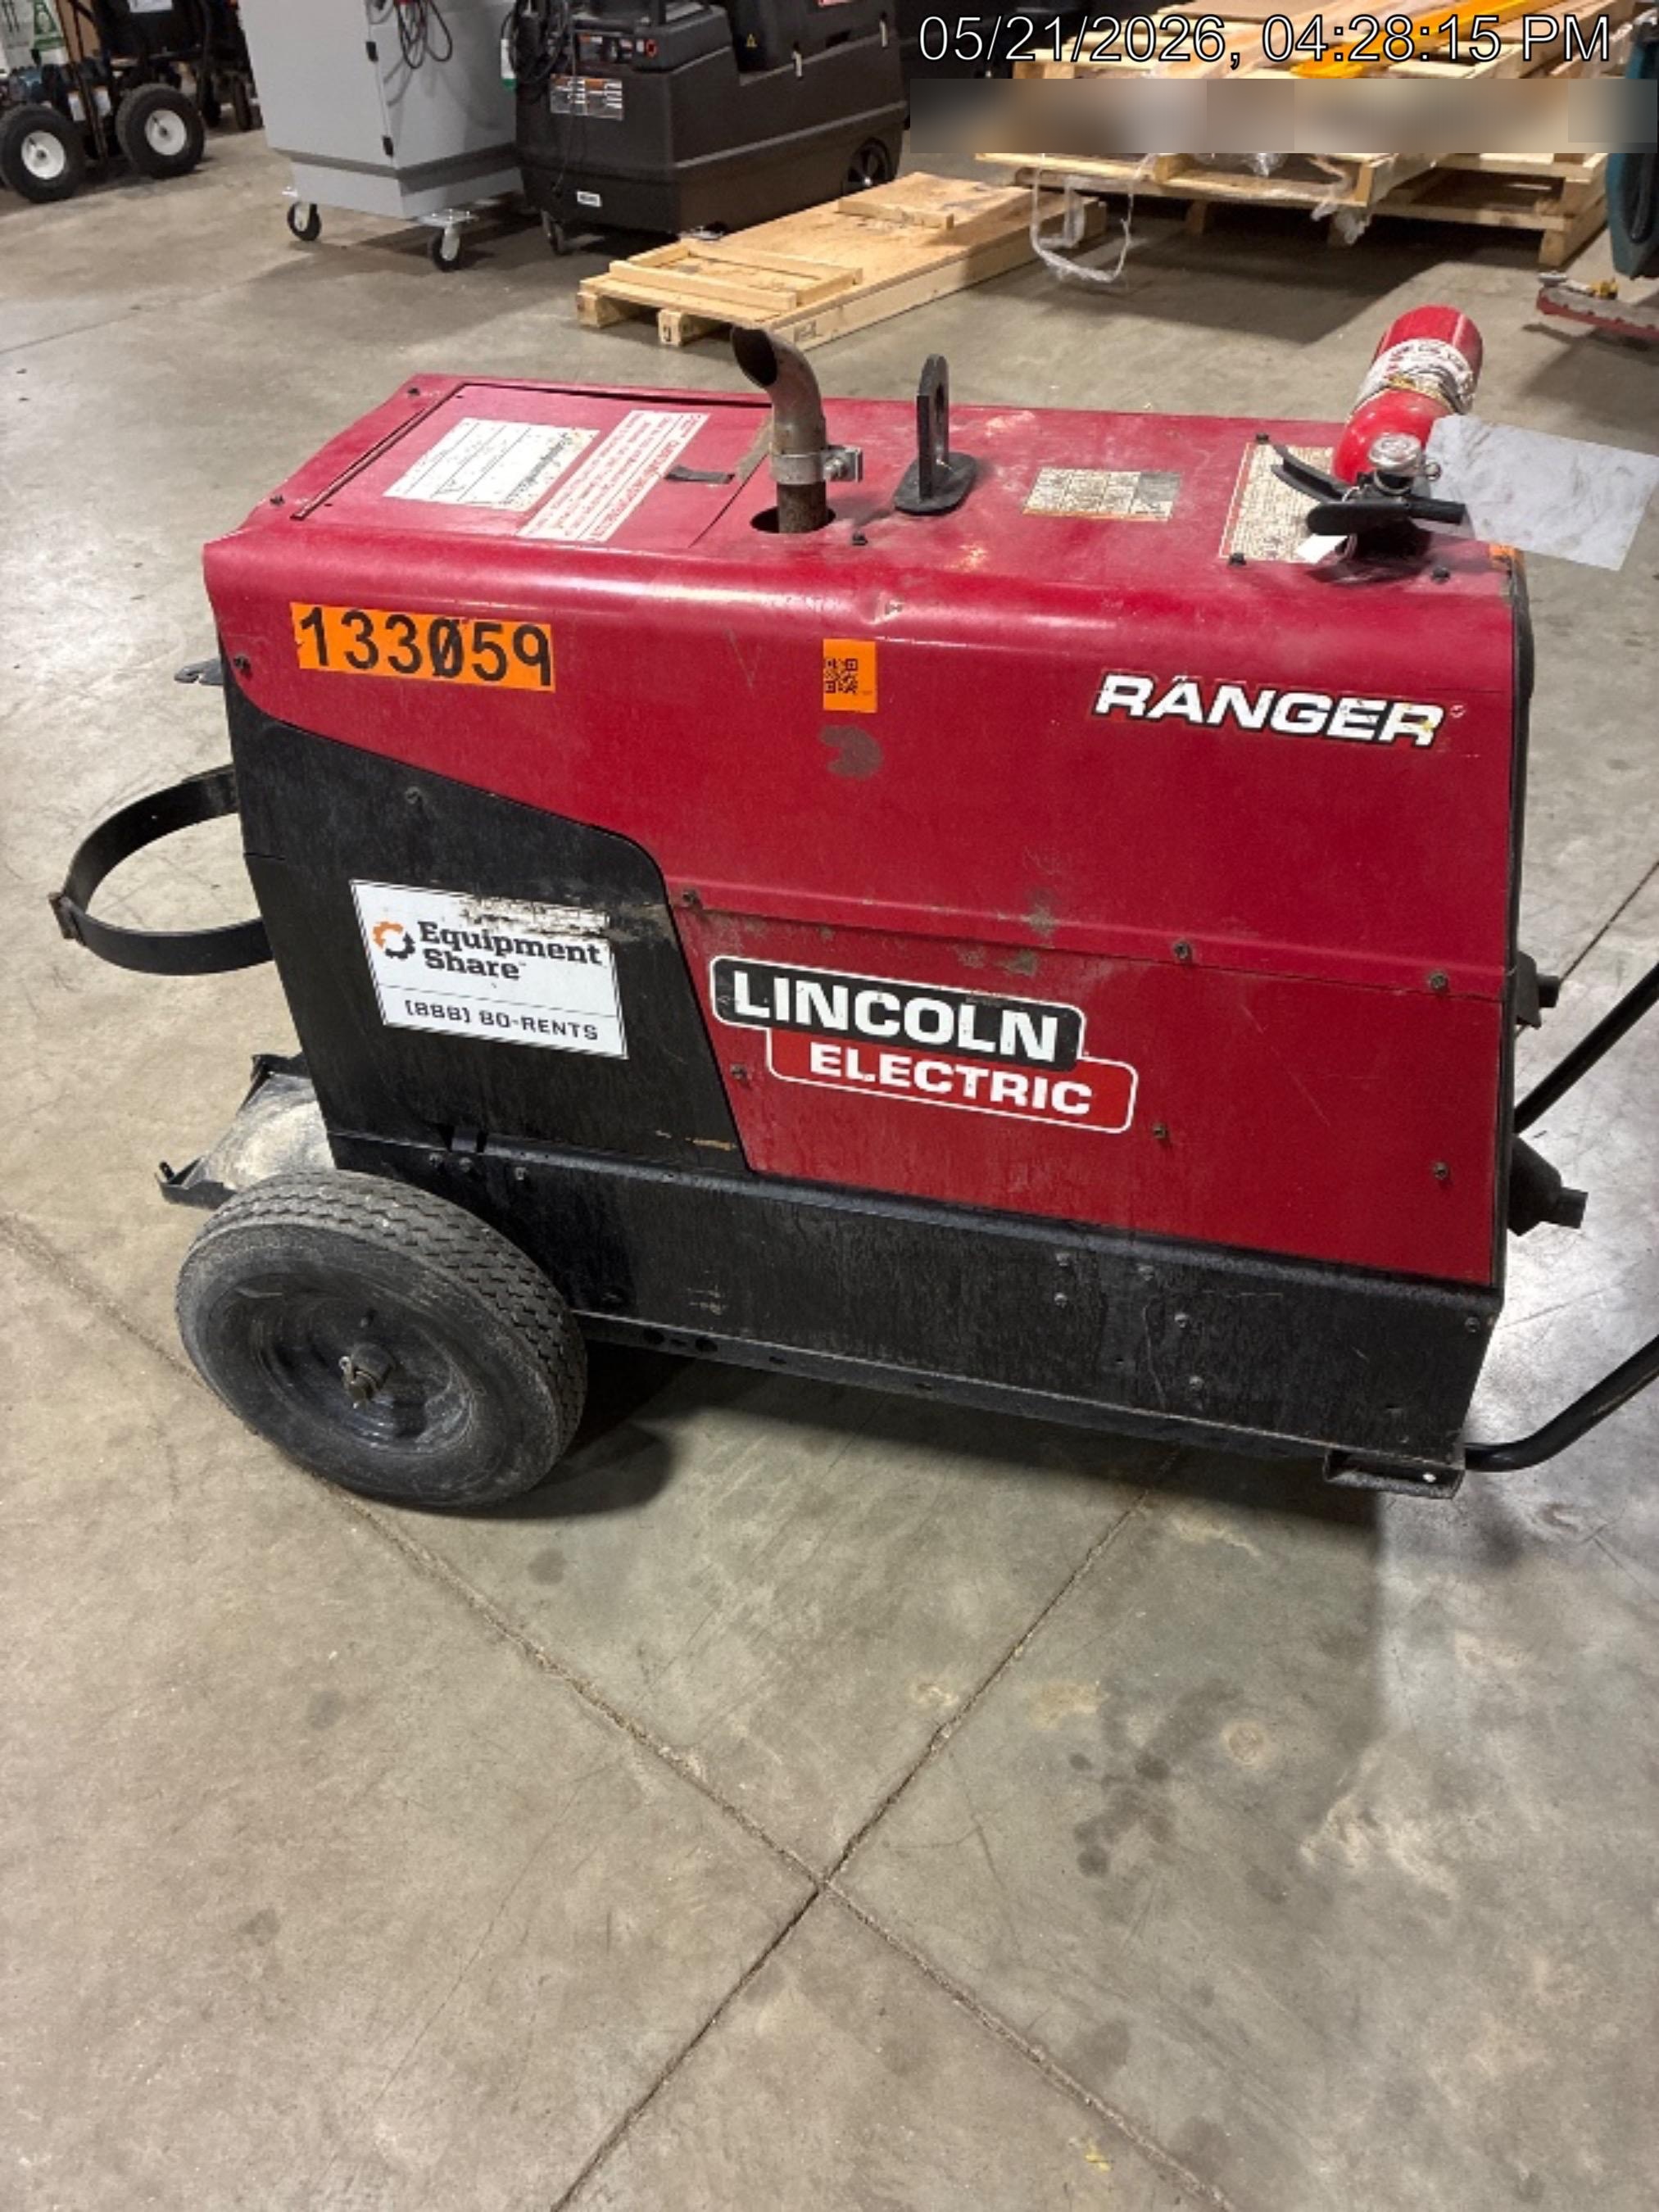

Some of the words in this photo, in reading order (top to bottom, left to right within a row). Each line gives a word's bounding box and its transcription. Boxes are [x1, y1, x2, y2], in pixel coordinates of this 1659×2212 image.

[300, 605, 554, 687] 133059
[1092, 672, 1448, 749] RANGER
[417, 921, 603, 965] Equipment
[422, 948, 519, 980] Share
[478, 1010, 599, 1040] 80-RENTS
[732, 970, 1058, 1063] LINCOLN
[809, 1041, 1093, 1117] ELECTRIC
